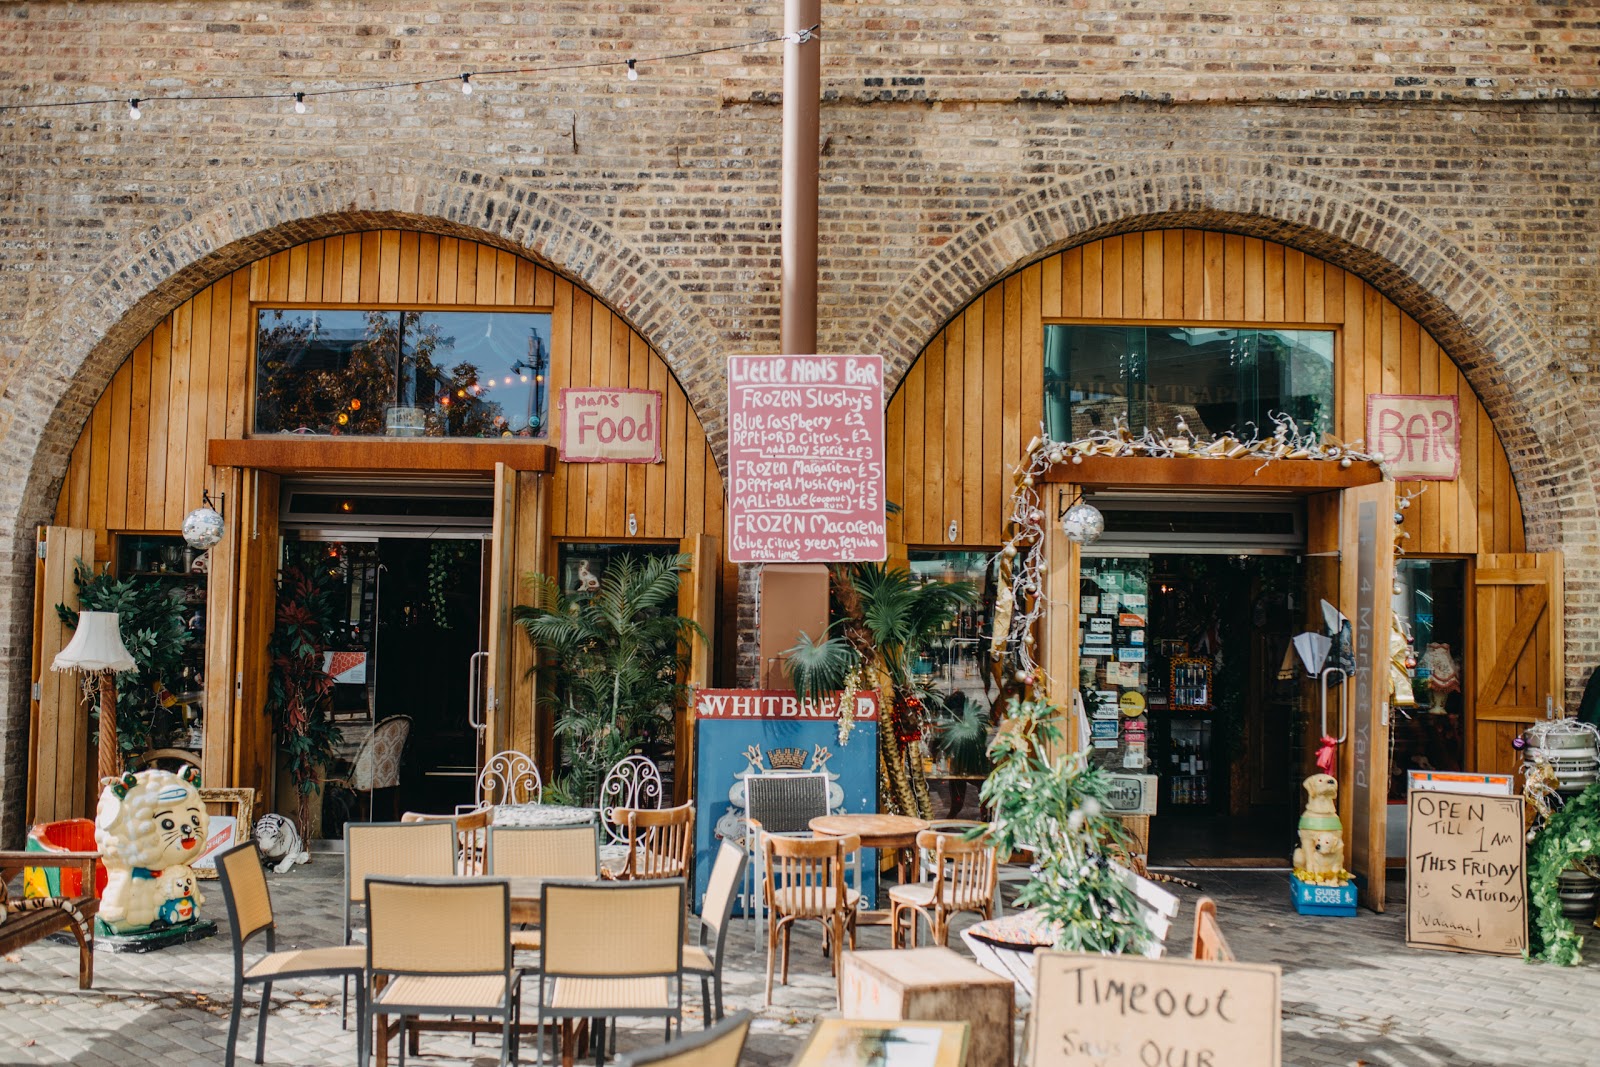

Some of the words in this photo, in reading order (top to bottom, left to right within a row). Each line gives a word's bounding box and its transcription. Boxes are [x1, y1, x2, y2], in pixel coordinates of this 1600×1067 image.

[731, 358, 787, 383] Little
[791, 357, 838, 382] NAN'S
[845, 358, 880, 387] BAR
[806, 388, 873, 412] Slushy's
[733, 411, 765, 431] Blue
[844, 412, 866, 426] £2
[852, 429, 872, 443] £2
[1378, 408, 1454, 464] BAR
[812, 444, 844, 456] Spirit
[792, 460, 851, 477] Margarita
[810, 514, 884, 535] Macarena
[1358, 607, 1372, 711] Market
[1356, 724, 1369, 788] Yard
[1417, 797, 1484, 822] OPEN
[1490, 833, 1513, 846] AM
[1416, 852, 1457, 874] THIS
[1315, 887, 1341, 896] GUIDE
[1315, 896, 1341, 904] DOGS
